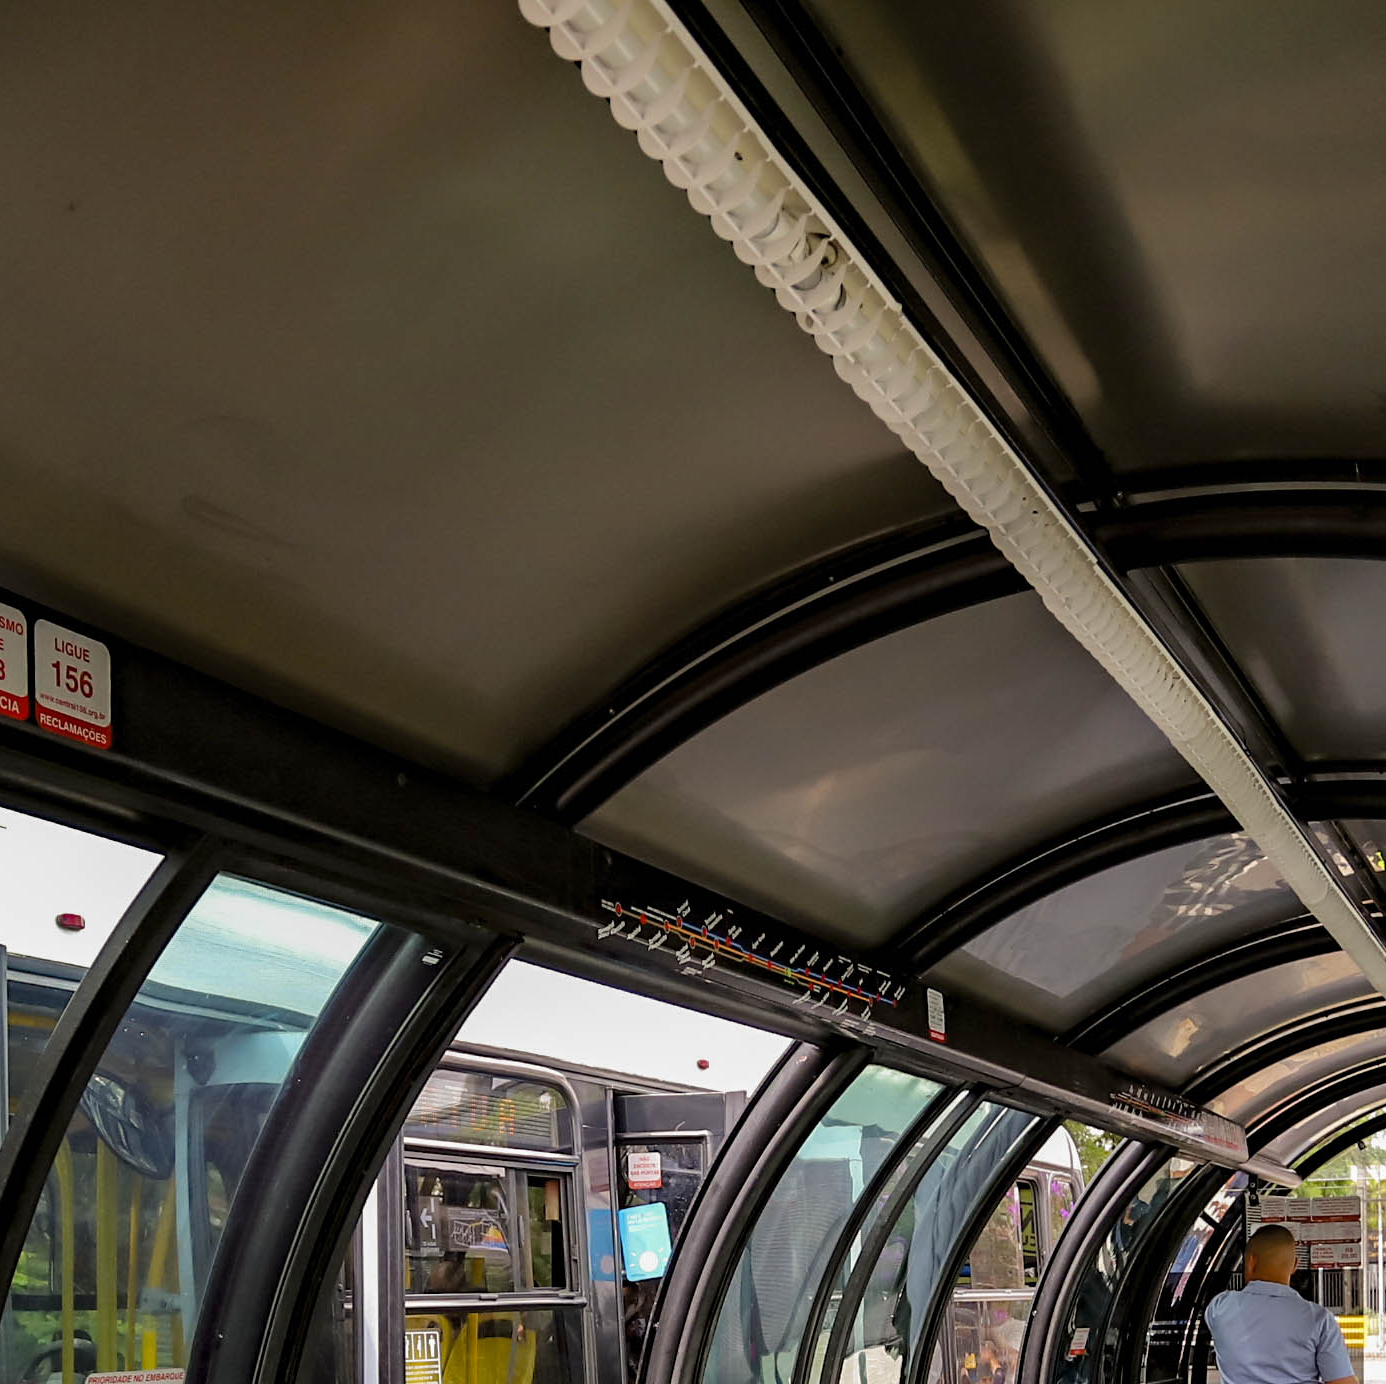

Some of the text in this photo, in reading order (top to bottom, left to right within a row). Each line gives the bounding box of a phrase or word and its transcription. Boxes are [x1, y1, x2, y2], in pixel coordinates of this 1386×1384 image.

[54, 637, 90, 663] LIGUE
[51, 661, 93, 699] 156
[40, 713, 107, 744] RECLAMAÇÕES
[88, 1375, 131, 1384] PRIORIDADE
[146, 1372, 184, 1381] EMBARQUE
